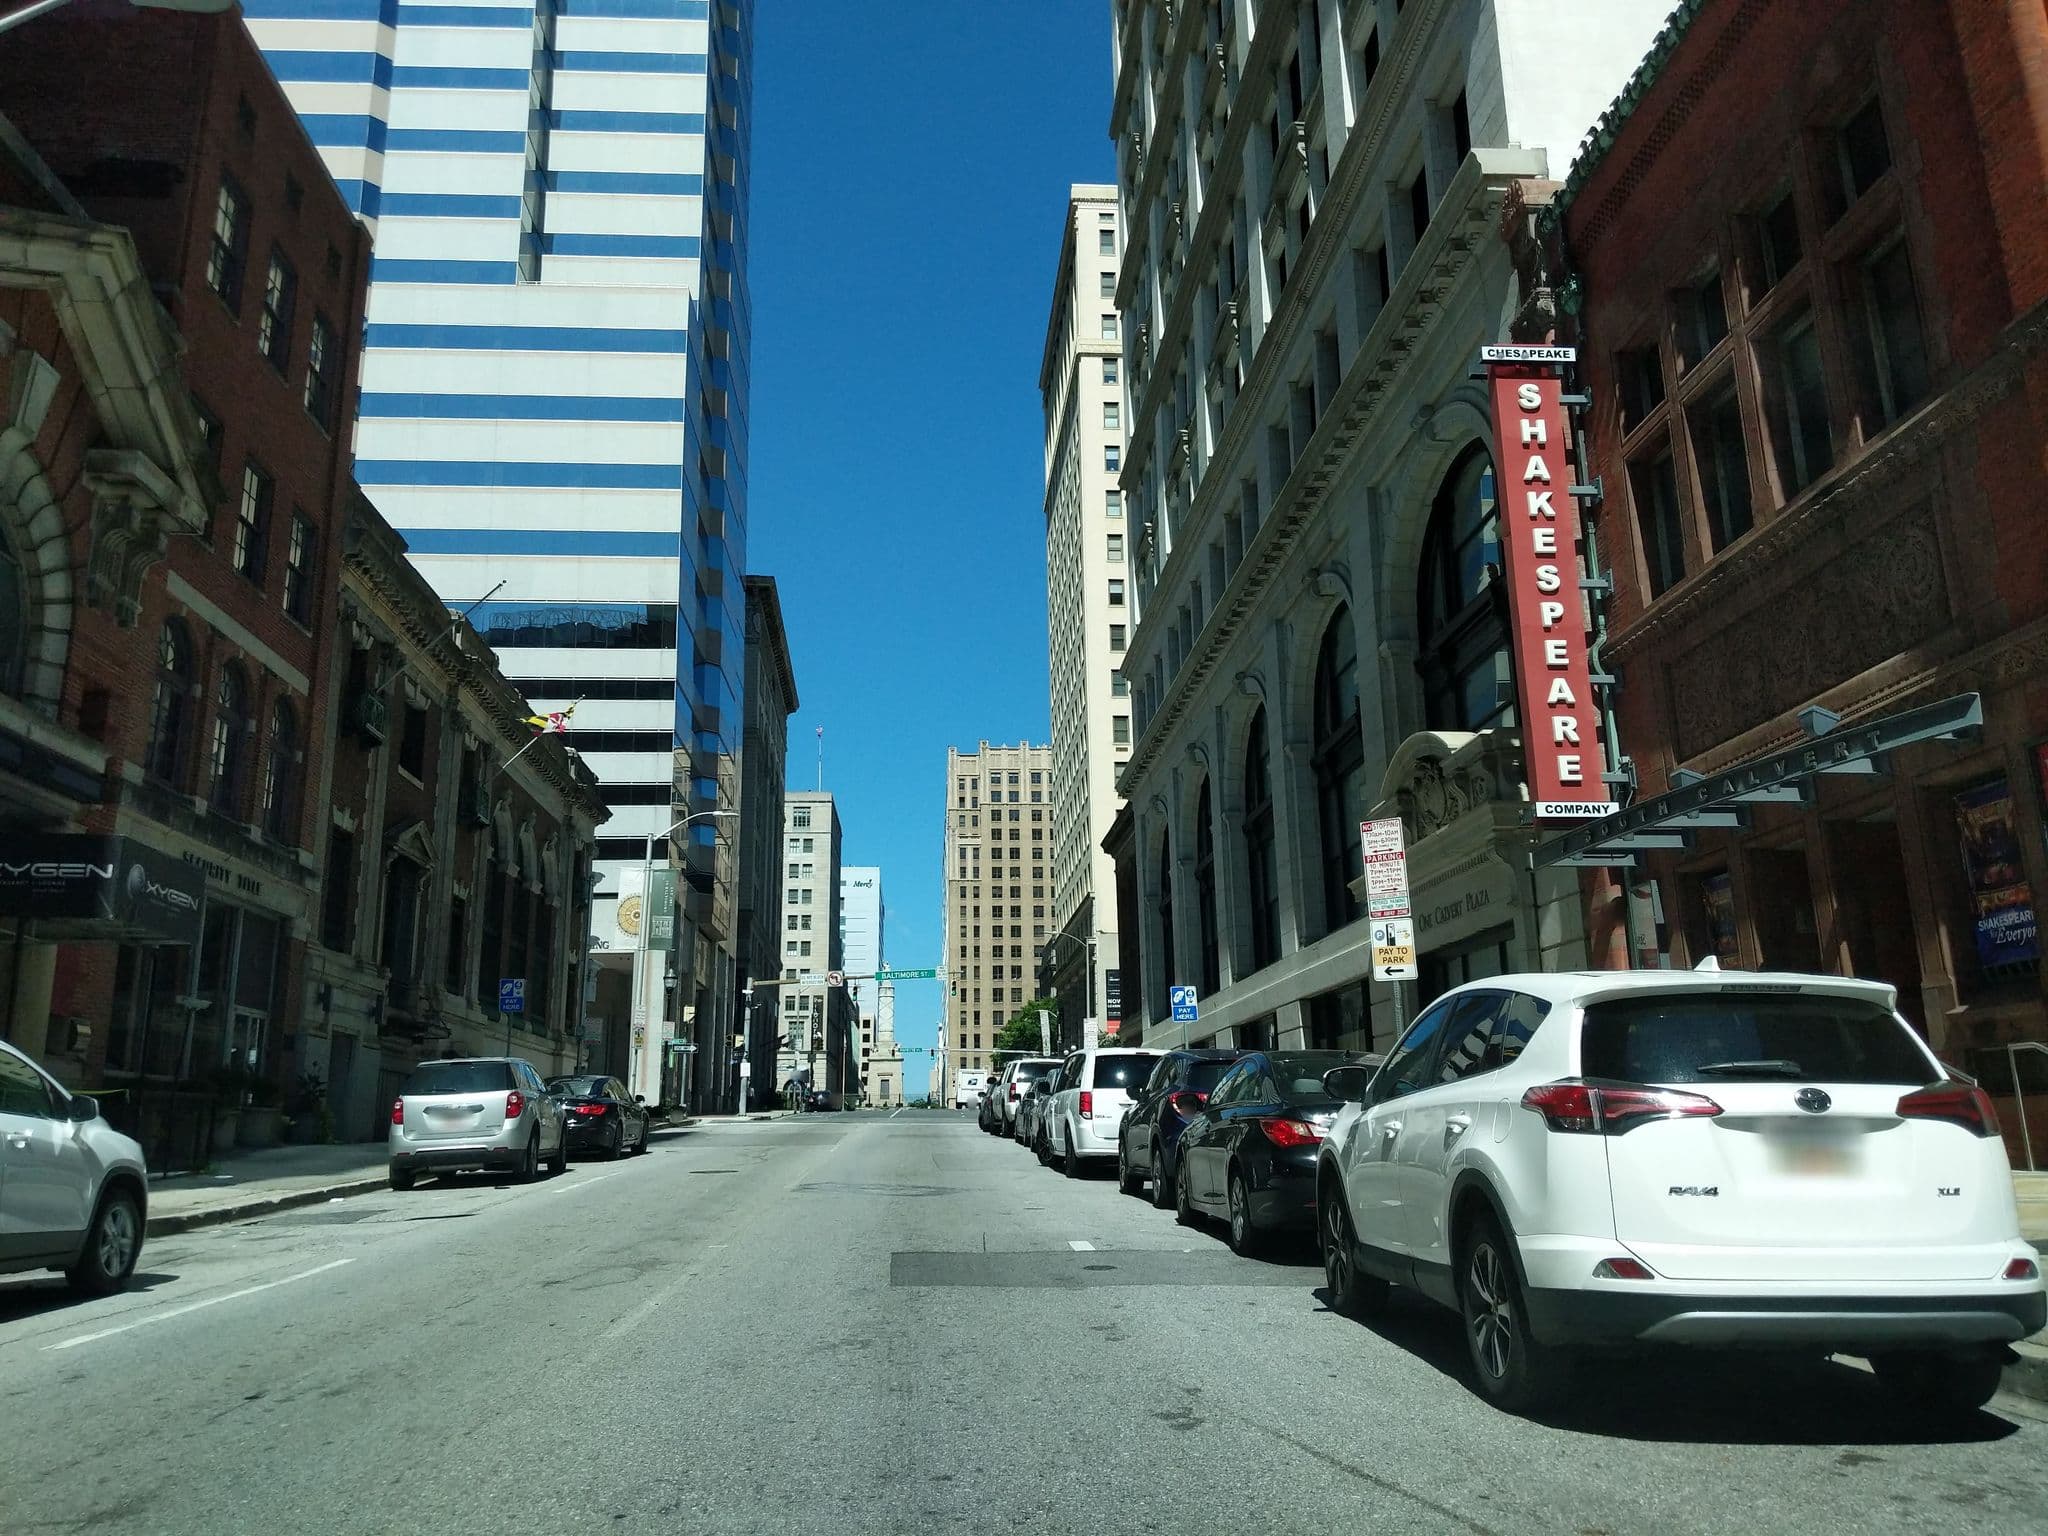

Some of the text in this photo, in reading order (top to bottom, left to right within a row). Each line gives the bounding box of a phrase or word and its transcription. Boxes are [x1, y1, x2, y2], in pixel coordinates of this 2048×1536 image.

[1487, 349, 1571, 359] CHESAPEAKE
[1517, 383, 1583, 782] SHAKESPEARE
[1698, 730, 1879, 800] CALVERT
[1544, 804, 1610, 814] COMPANY
[1362, 821, 1399, 832] NO STOPPING
[1367, 853, 1402, 863] PARKING
[1380, 861, 1401, 869] MINUTE
[0, 863, 113, 879] YGEN
[1419, 888, 1490, 932] ONE CALVERT PLAZA
[1978, 910, 2034, 932] SHAKESPEAR
[1379, 947, 1408, 956] PAY TO
[1382, 956, 1405, 964] PARK
[882, 971, 919, 979] BALTIMORE
[1668, 1186, 1719, 1197] RAV4
[1937, 1187, 1960, 1198] XLE
